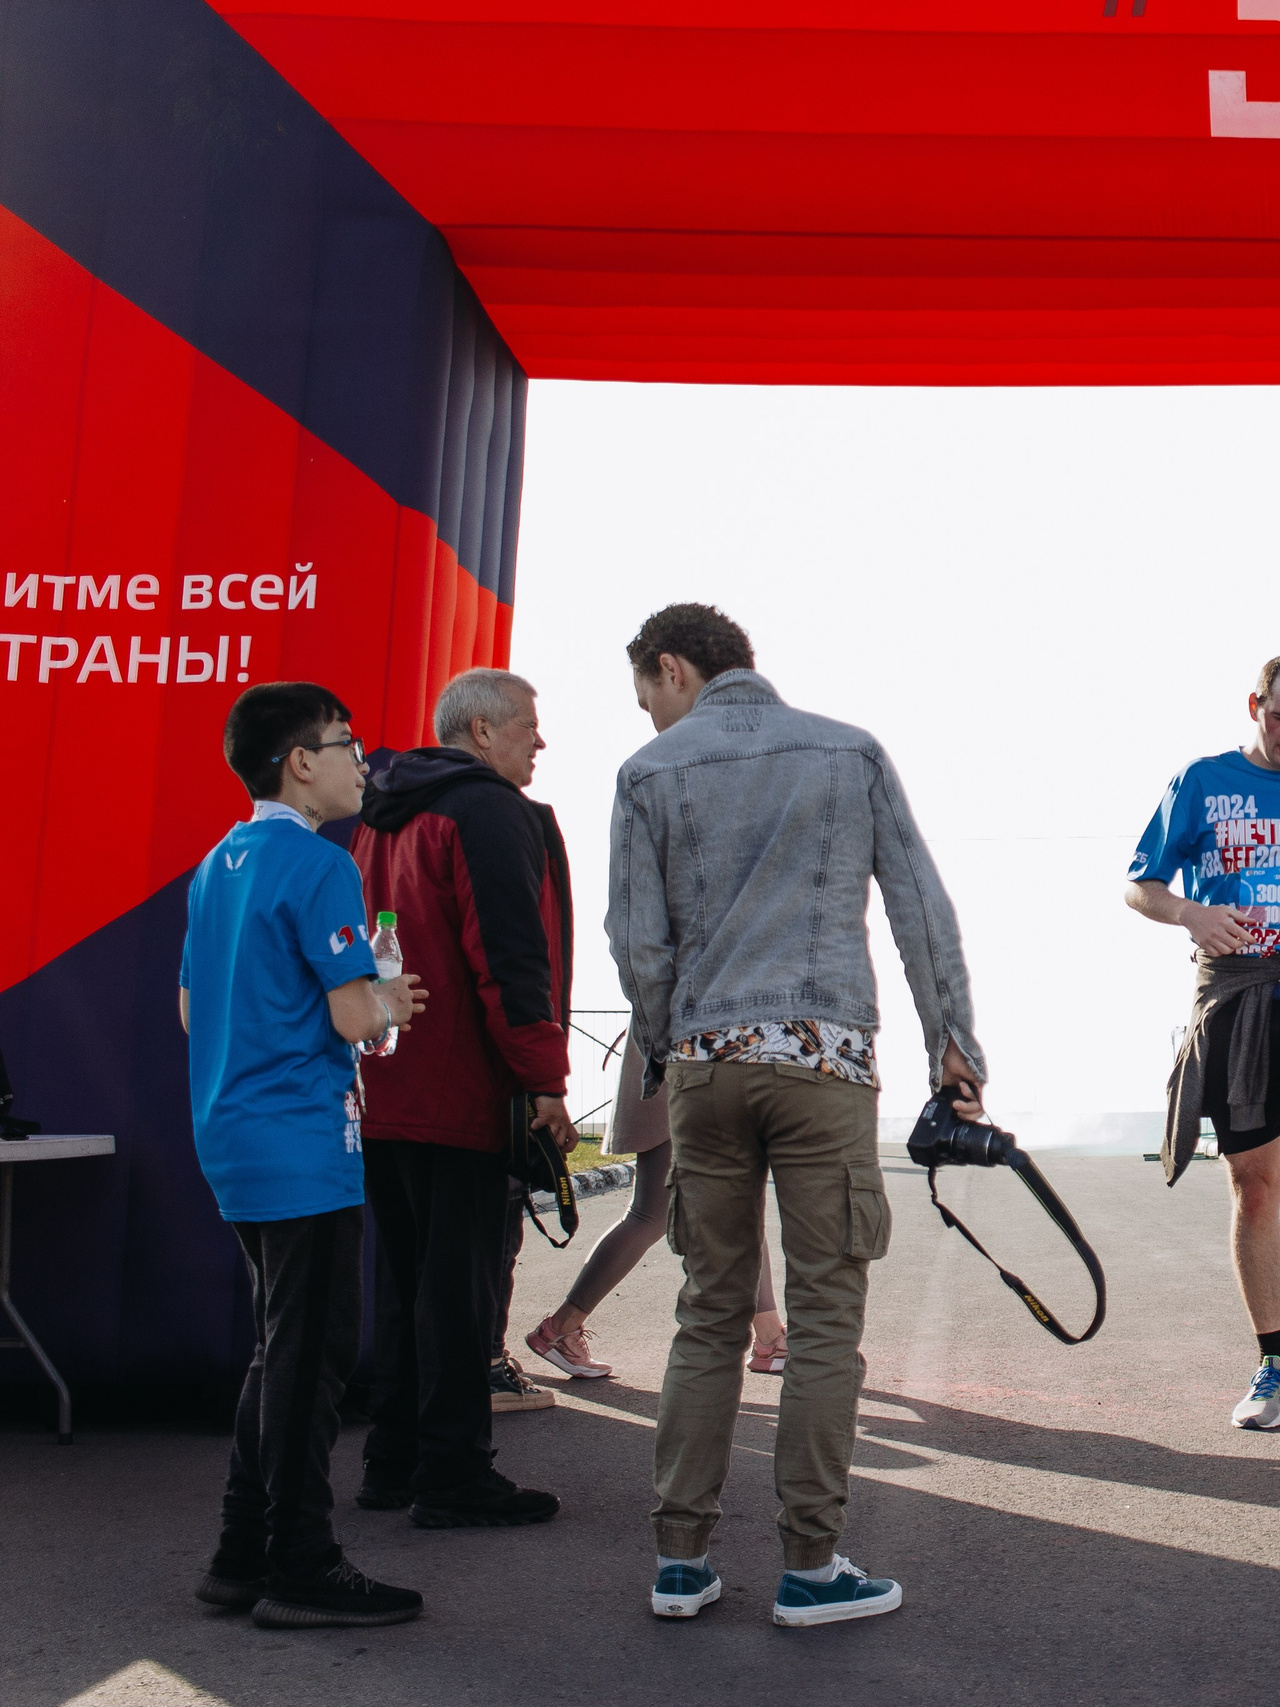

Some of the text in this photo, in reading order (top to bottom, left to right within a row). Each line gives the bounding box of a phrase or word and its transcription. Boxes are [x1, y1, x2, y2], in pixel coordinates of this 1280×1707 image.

[181, 561, 318, 611] всей
[0, 633, 253, 685] ТРАНЫ!
[1204, 794, 1259, 824] 2024
[1135, 851, 1149, 864] СБ
[560, 1176, 572, 1206] Nikon
[1024, 1294, 1050, 1322] Nikon
